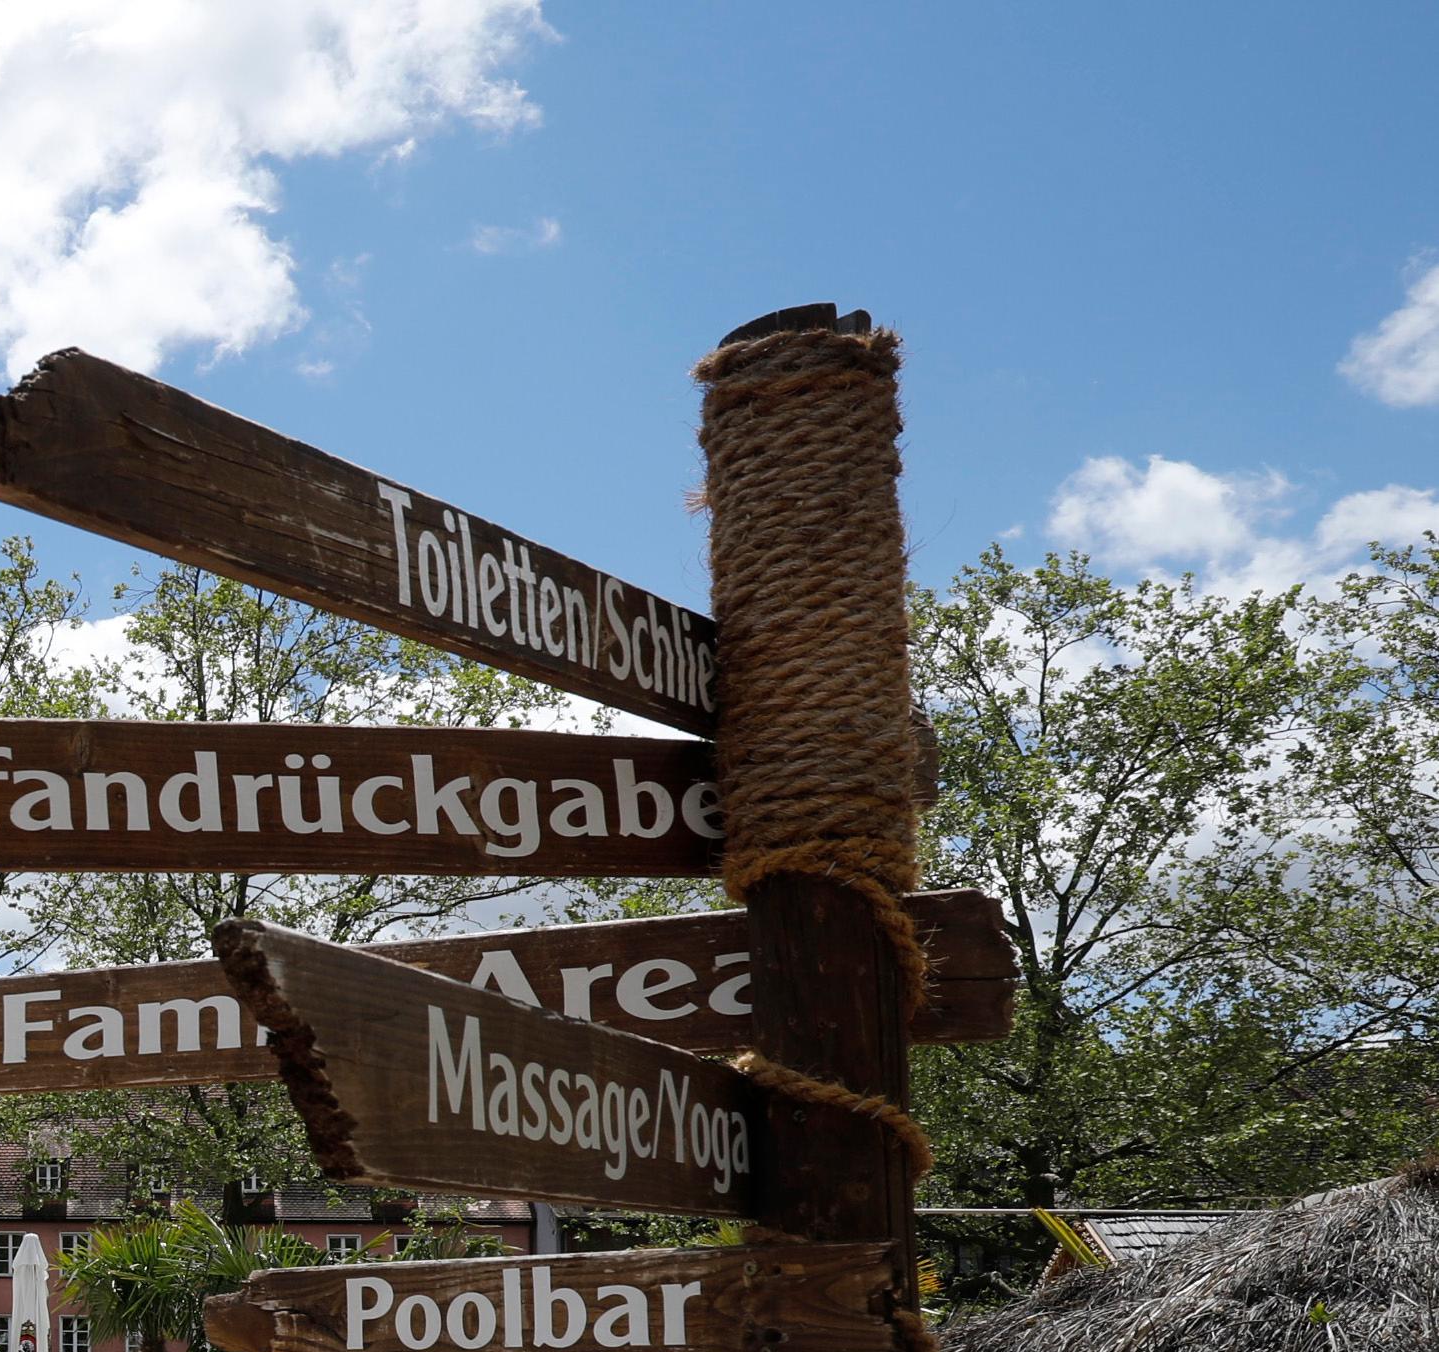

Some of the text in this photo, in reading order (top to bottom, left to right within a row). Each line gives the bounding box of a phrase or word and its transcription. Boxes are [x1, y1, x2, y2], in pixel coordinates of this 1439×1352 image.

[3, 988, 271, 1064] Fam
[428, 1004, 751, 1194] Massage/Yoga
[344, 1265, 702, 1350] Poolbar
